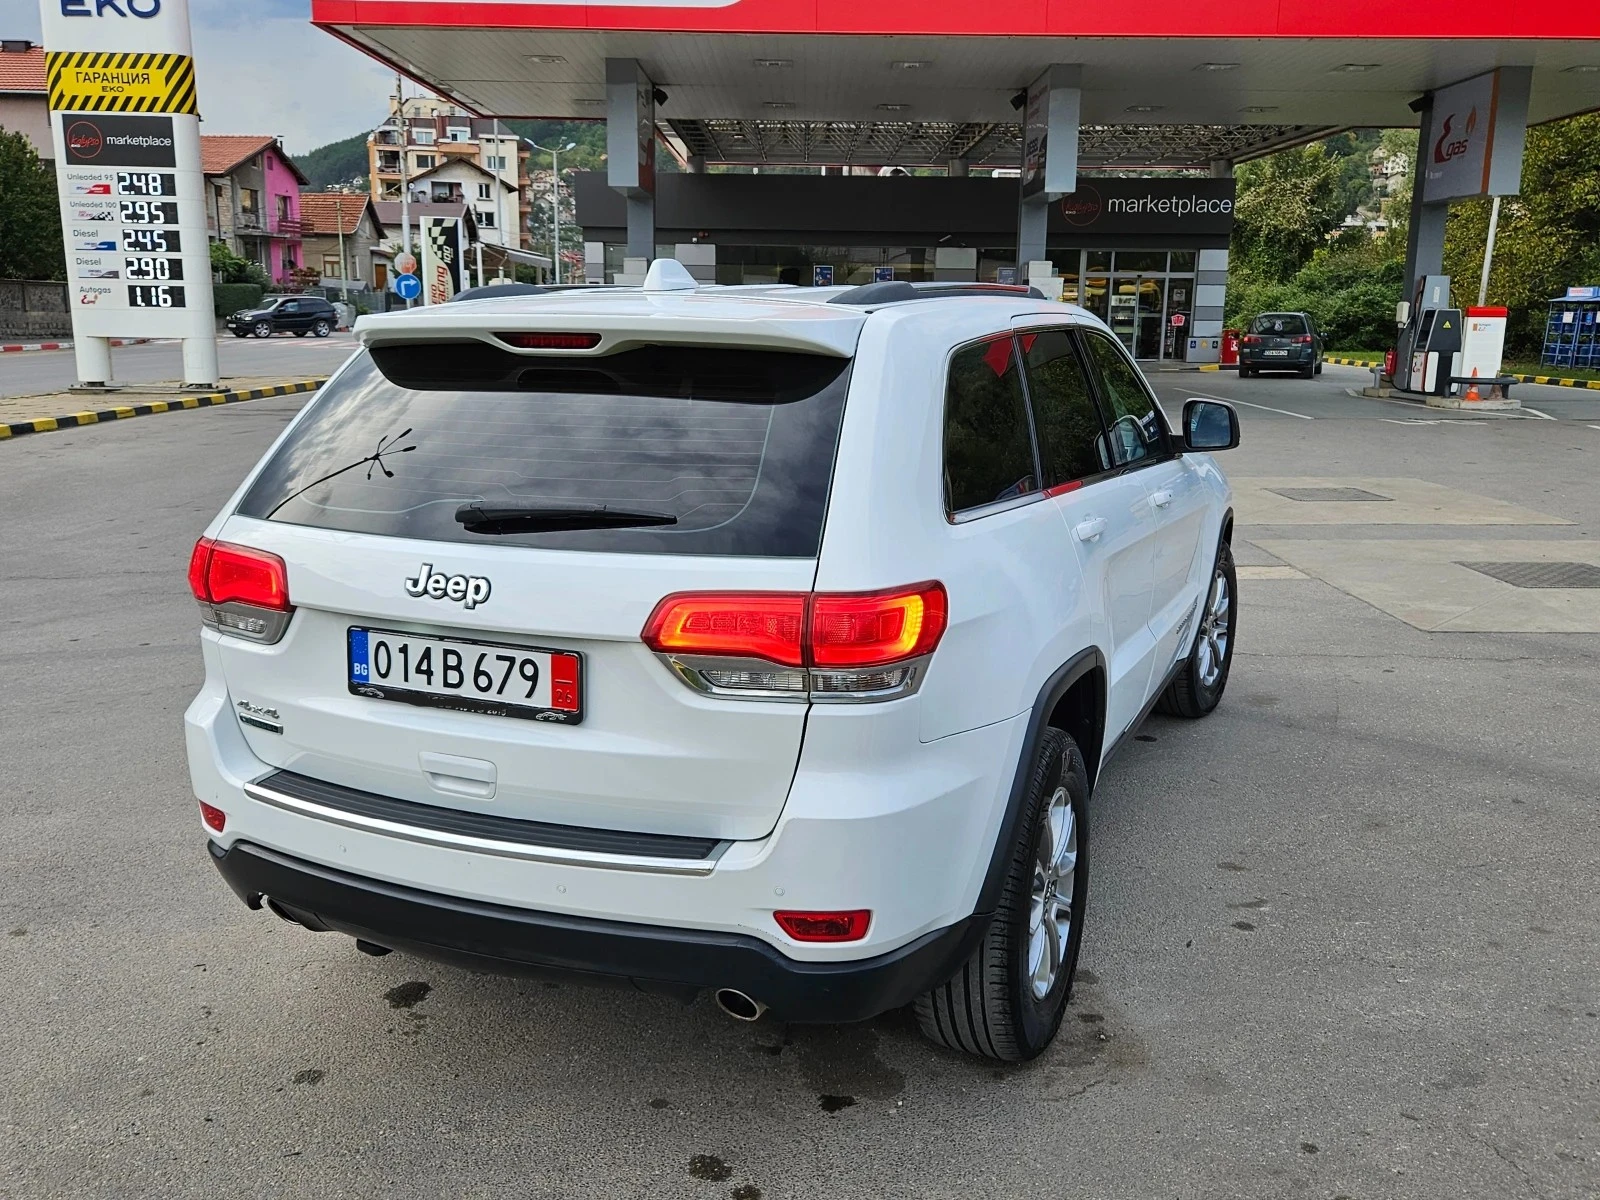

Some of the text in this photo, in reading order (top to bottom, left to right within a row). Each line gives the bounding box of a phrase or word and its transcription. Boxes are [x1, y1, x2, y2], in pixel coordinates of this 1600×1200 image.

[61, 0, 161, 18] EKO
[75, 71, 150, 86] ГАРАНЦИЯ
[101, 85, 125, 93] EKO
[106, 134, 172, 147] marketplace
[66, 173, 102, 181] Unleaded
[118, 172, 162, 196] 2.48
[120, 201, 165, 224] 2.95
[1108, 194, 1232, 218] marketplace
[73, 230, 99, 238] Diesel
[123, 229, 168, 252] 2.45
[75, 258, 102, 266] Diesel
[443, 245, 451, 264] 100
[126, 257, 170, 280] 2.90
[79, 286, 112, 294] Autogas
[135, 286, 172, 307] 1.16
[404, 562, 492, 611] Jeep
[353, 662, 369, 676] BG
